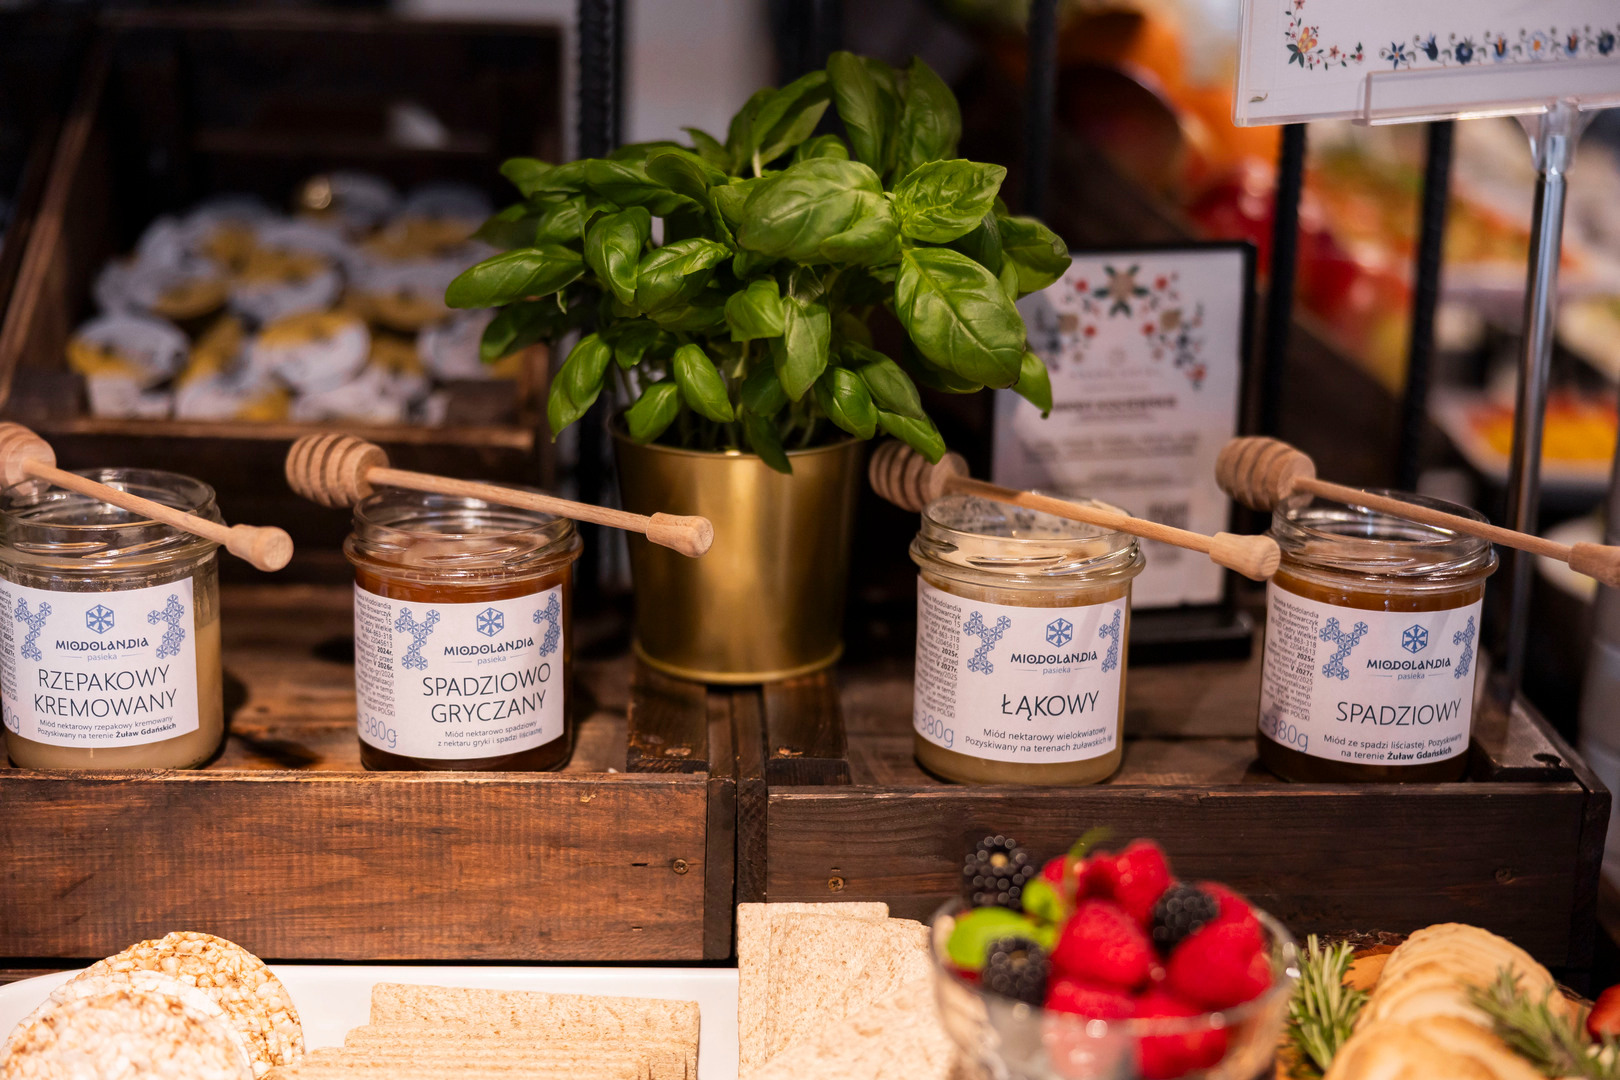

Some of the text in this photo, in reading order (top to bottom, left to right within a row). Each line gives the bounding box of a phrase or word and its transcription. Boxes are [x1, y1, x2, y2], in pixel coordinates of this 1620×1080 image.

[1311, 624, 1318, 633] 15
[55, 637, 149, 651] MIODOLANDIA
[444, 637, 534, 656] MIODOLANDIA
[87, 653, 117, 662] pasieka
[477, 655, 507, 666] pasieka
[942, 647, 959, 659] 2025r.
[1010, 651, 1098, 664] MIODOLANDIA
[1297, 652, 1315, 663] 2025r.
[1042, 666, 1070, 675] pasieka
[1366, 657, 1451, 671] MIODOLANDIA
[38, 664, 170, 692] RZEPAKOWY
[1296, 666, 1313, 678] 2027r.
[1397, 672, 1425, 681] pasieka
[422, 663, 551, 697] SPADZIOWO
[34, 688, 177, 718] KREMOWANY
[431, 689, 546, 723] GRYCZANY
[1001, 690, 1099, 721] ŁĄKOWY
[1336, 698, 1462, 726] SPADZIOWY
[37, 728, 76, 740] Pozyskiwany
[140, 723, 176, 735] Gdańskich
[40, 716, 173, 732] Miód nektarowy rzepakowy kremowany
[445, 720, 537, 738] Miód nektarowo spadziowy
[443, 739, 471, 747] nektaru
[473, 737, 491, 748] gryki
[496, 734, 518, 745] spadzi
[983, 728, 1005, 739] Miód
[1009, 732, 1055, 742] nektarowy
[1056, 726, 1106, 741] wielokwiatowy
[965, 736, 1018, 754] Pozyskiwany
[1020, 743, 1031, 752] na
[1034, 740, 1070, 753] terenach
[1324, 734, 1345, 746] Miód
[1360, 740, 1389, 750] spadzi
[1341, 746, 1452, 760] na terenie Żuław Gdańskich
